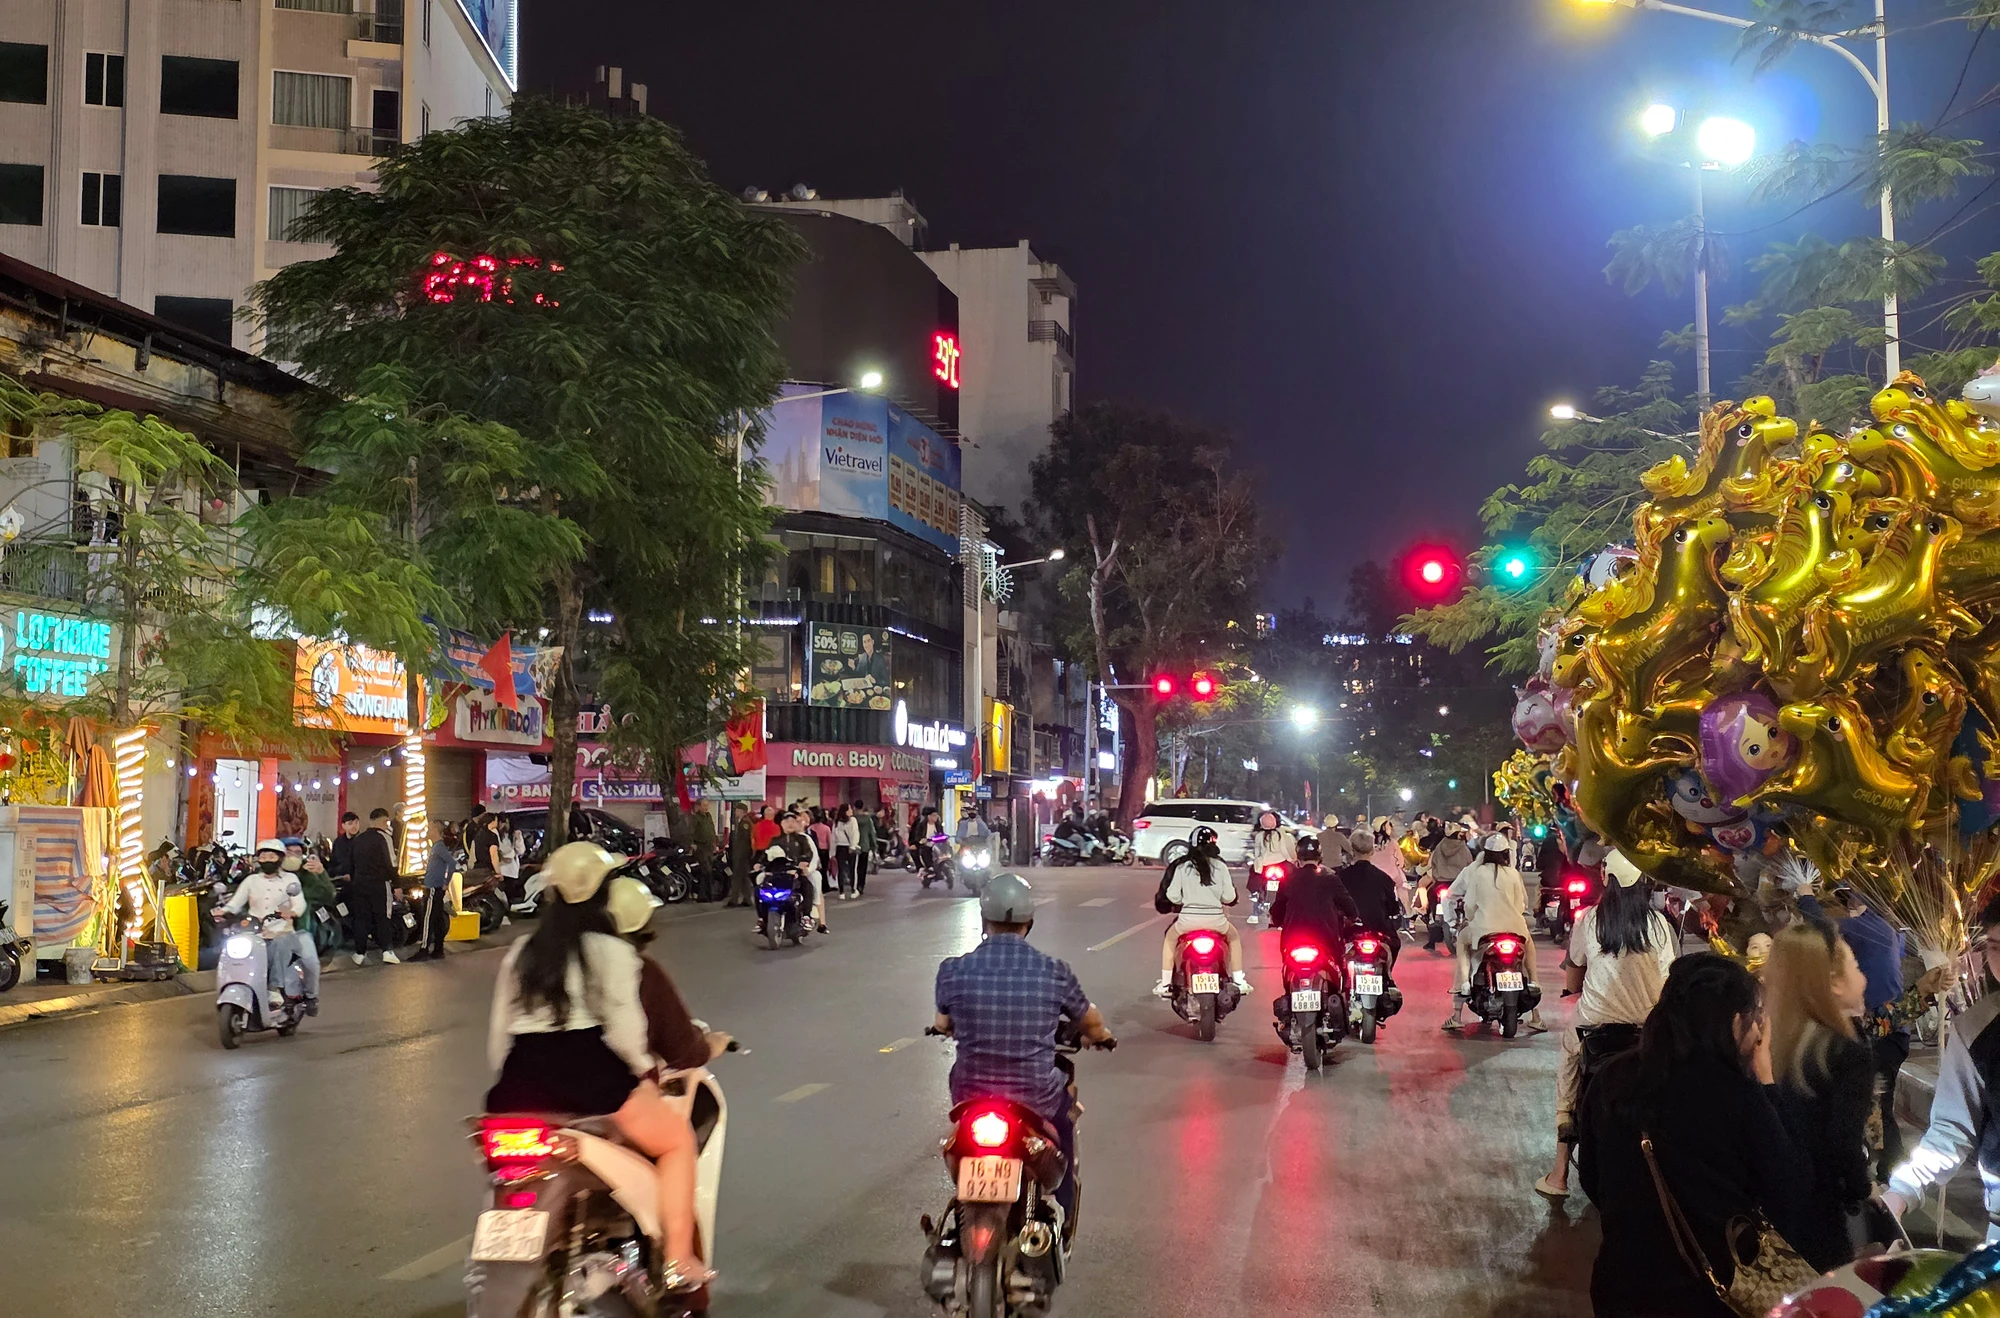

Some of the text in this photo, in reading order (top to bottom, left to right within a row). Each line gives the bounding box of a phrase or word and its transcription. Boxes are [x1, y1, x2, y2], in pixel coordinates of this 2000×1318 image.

[825, 446, 883, 473] Vietravel
[814, 635, 838, 650] 50%
[792, 749, 834, 767] Mom
[836, 752, 845, 767] &
[848, 750, 885, 770] Baby
[1853, 788, 1882, 806] CHÚC
